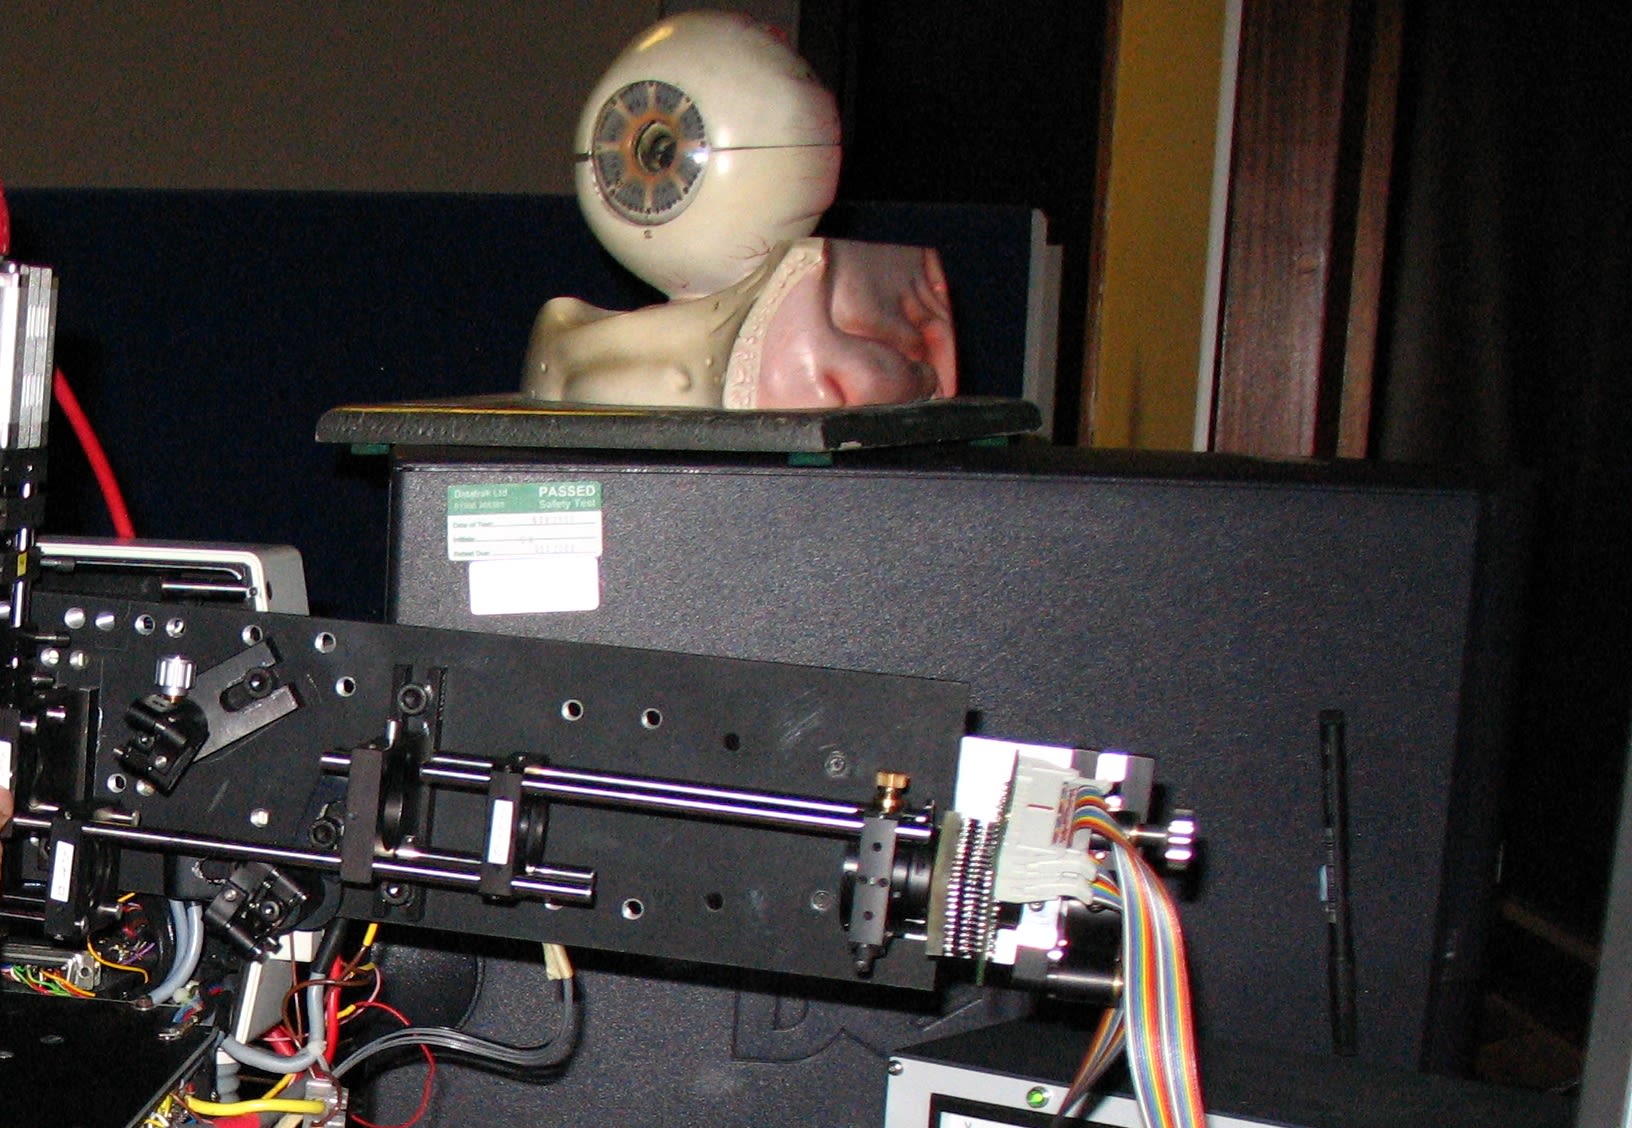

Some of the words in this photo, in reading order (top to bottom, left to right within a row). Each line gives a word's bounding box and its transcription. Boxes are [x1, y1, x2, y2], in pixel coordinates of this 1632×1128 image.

[493, 488, 508, 497] Ltd
[538, 485, 596, 498] PASSED
[538, 499, 571, 510] Safety
[574, 499, 596, 508] Test
